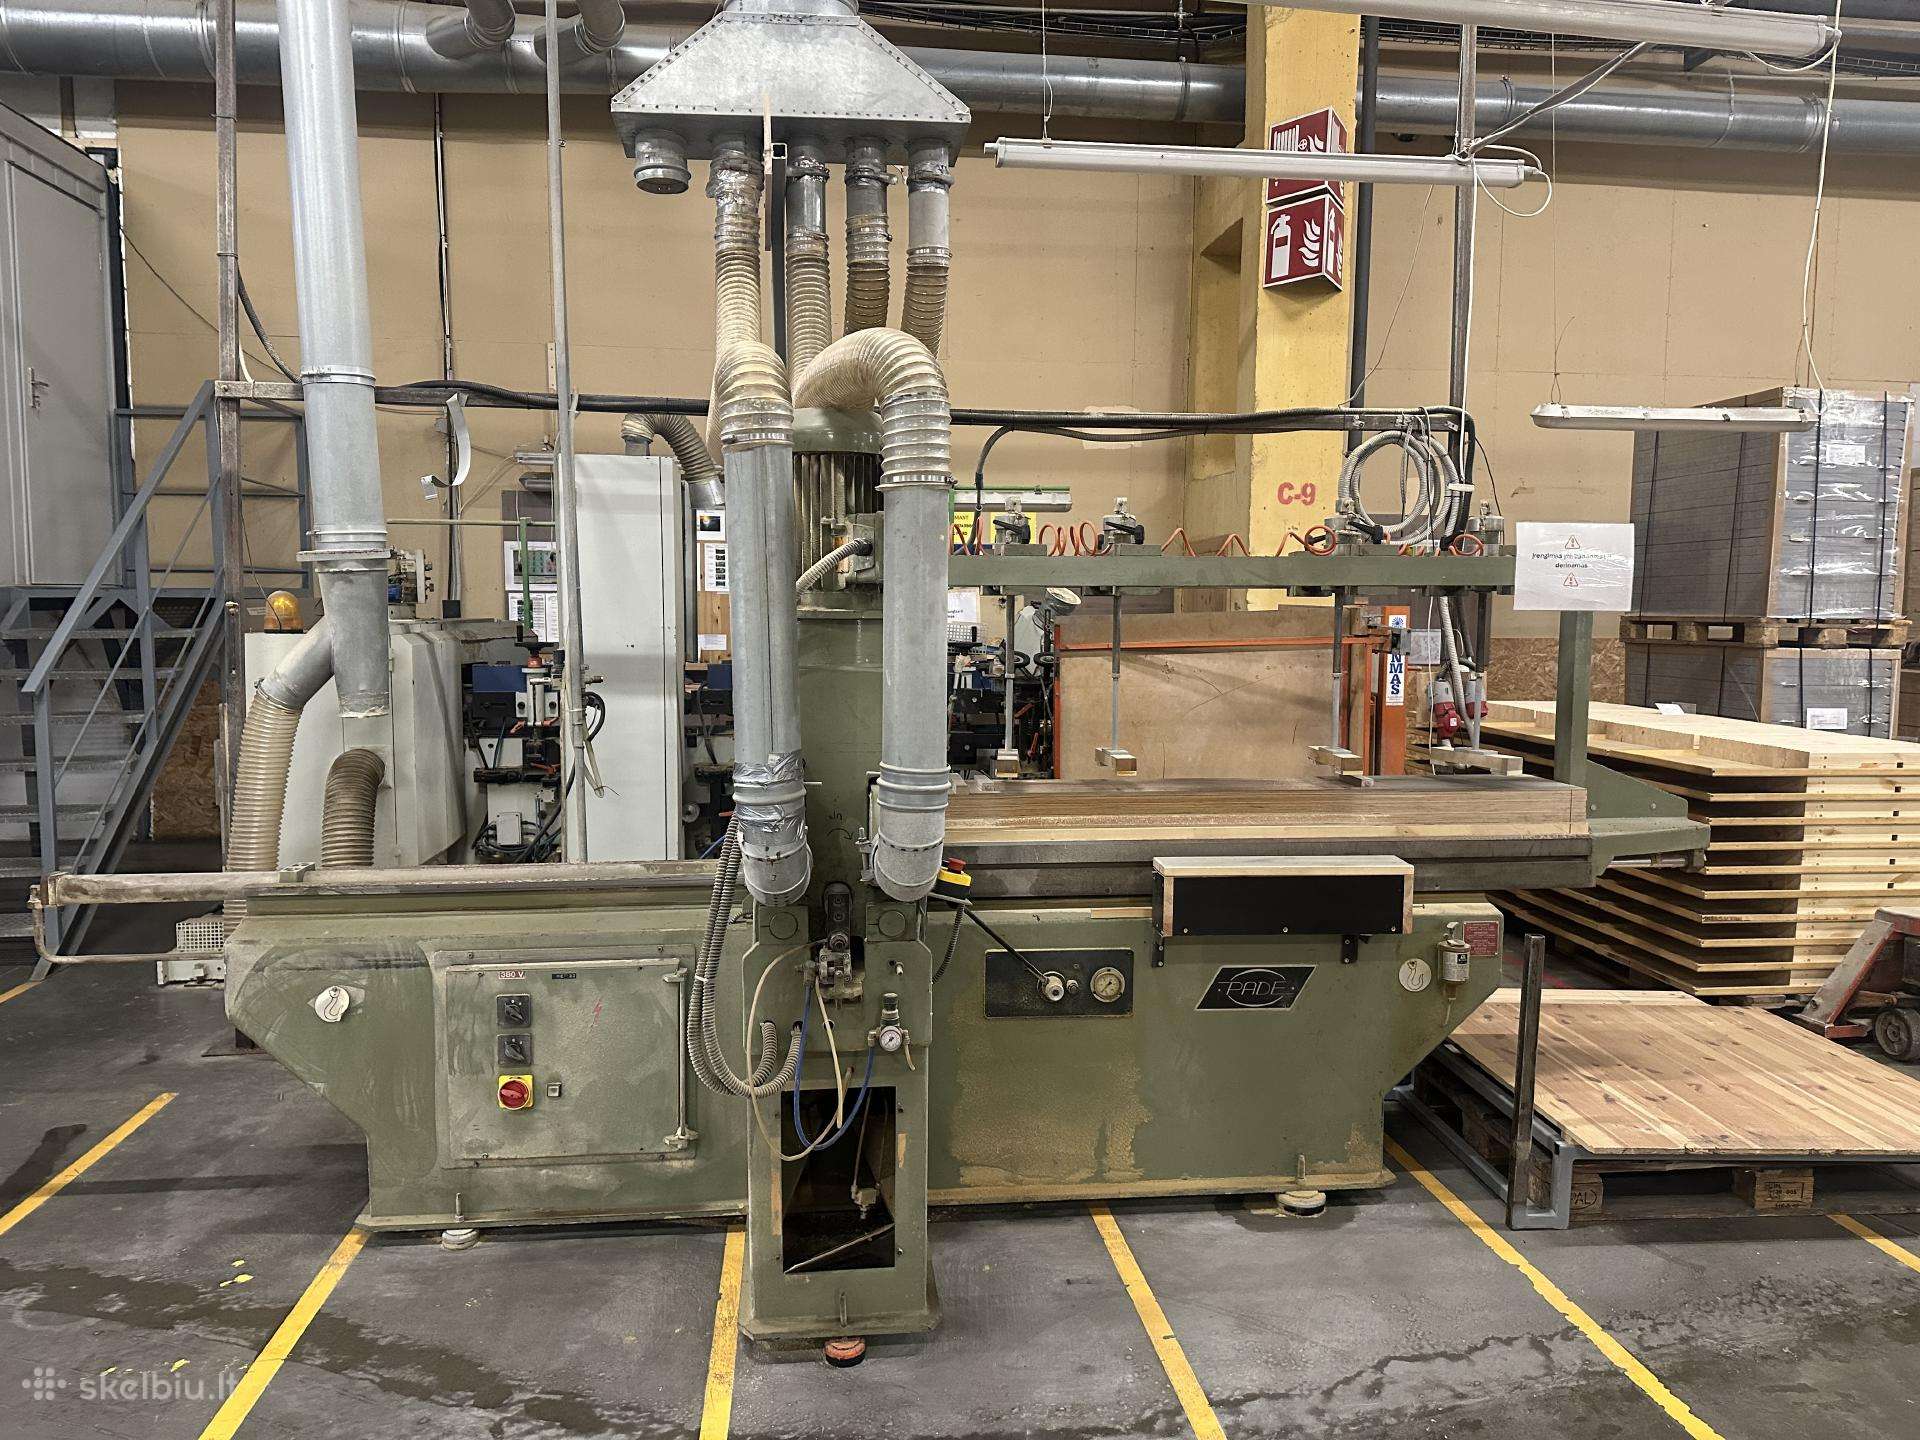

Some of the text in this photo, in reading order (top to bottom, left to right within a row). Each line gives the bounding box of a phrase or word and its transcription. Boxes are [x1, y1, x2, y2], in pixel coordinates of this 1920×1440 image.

[1278, 482, 1316, 506] C-9
[500, 971, 516, 979] 380
[1218, 981, 1294, 996] PADE
